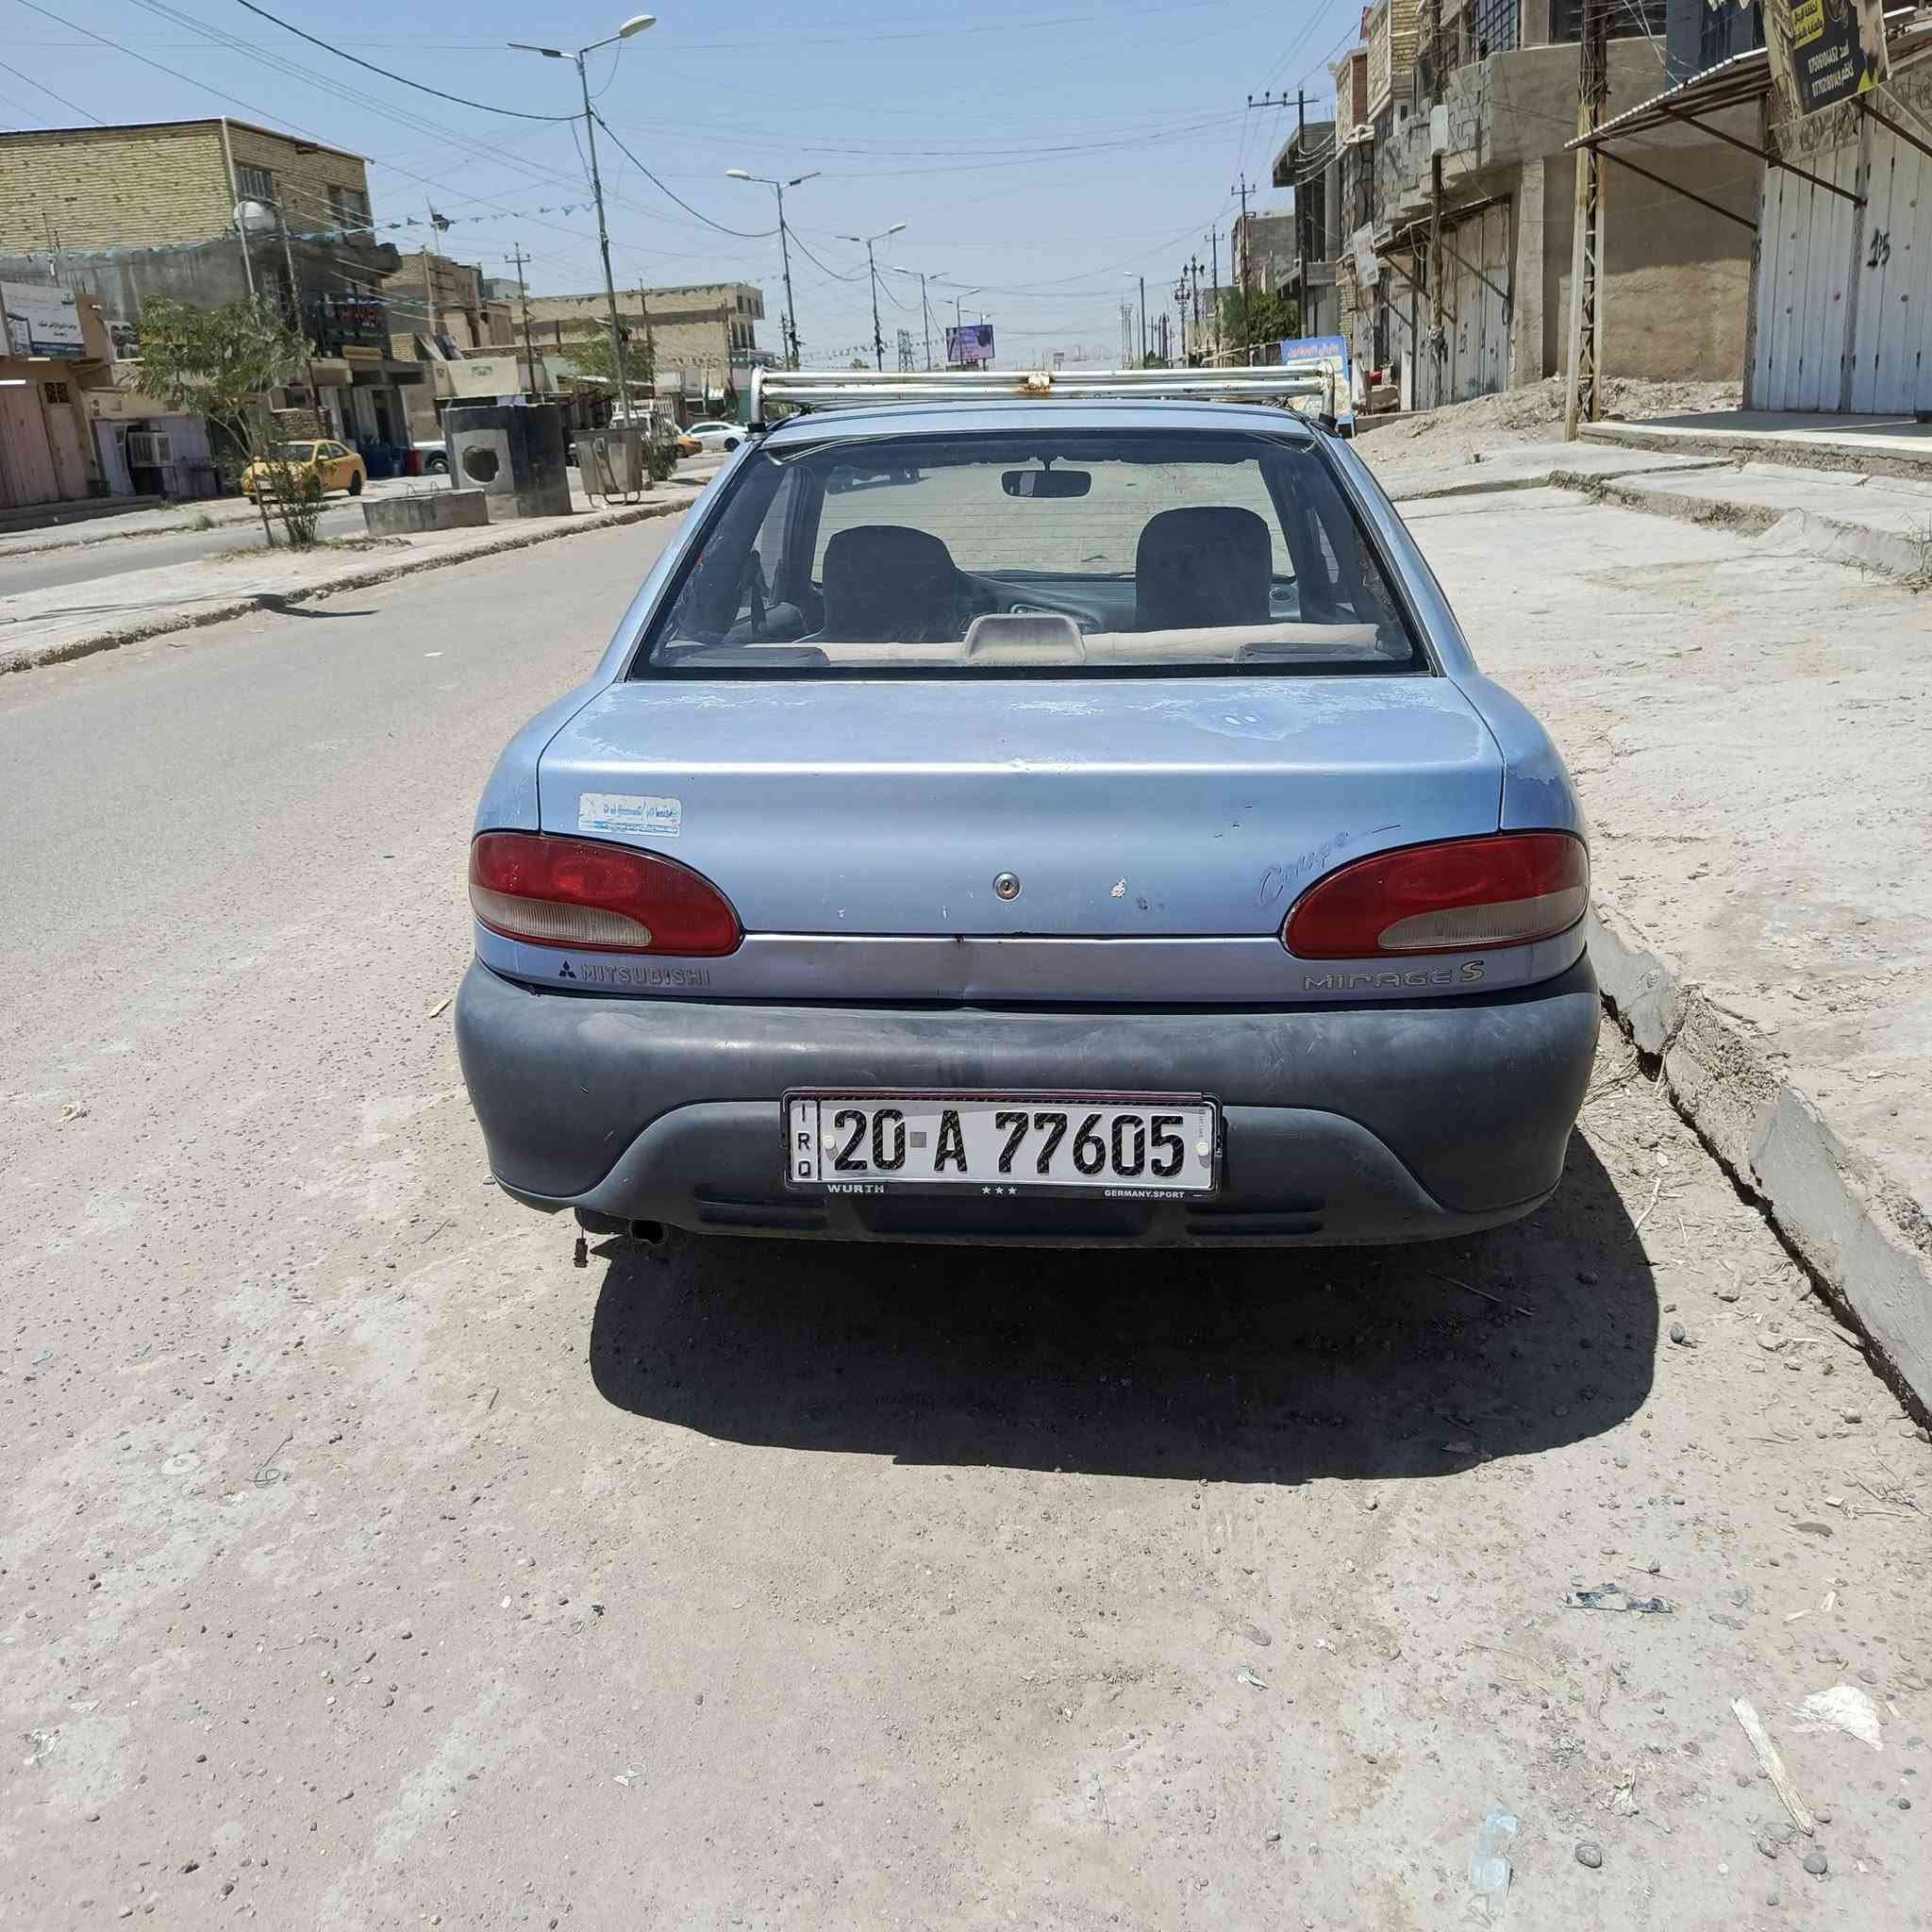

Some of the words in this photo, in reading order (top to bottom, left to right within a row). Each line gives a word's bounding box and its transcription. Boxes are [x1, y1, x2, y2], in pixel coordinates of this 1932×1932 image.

[581, 962, 710, 986] MITSUBISHI
[1305, 970, 1453, 990] MIRAGE
[1460, 959, 1485, 983] S
[834, 1108, 906, 1171] 20
[934, 1110, 968, 1172] A
[995, 1111, 1185, 1177] 77605
[1104, 1189, 1186, 1199] GERMANY.SPORT
